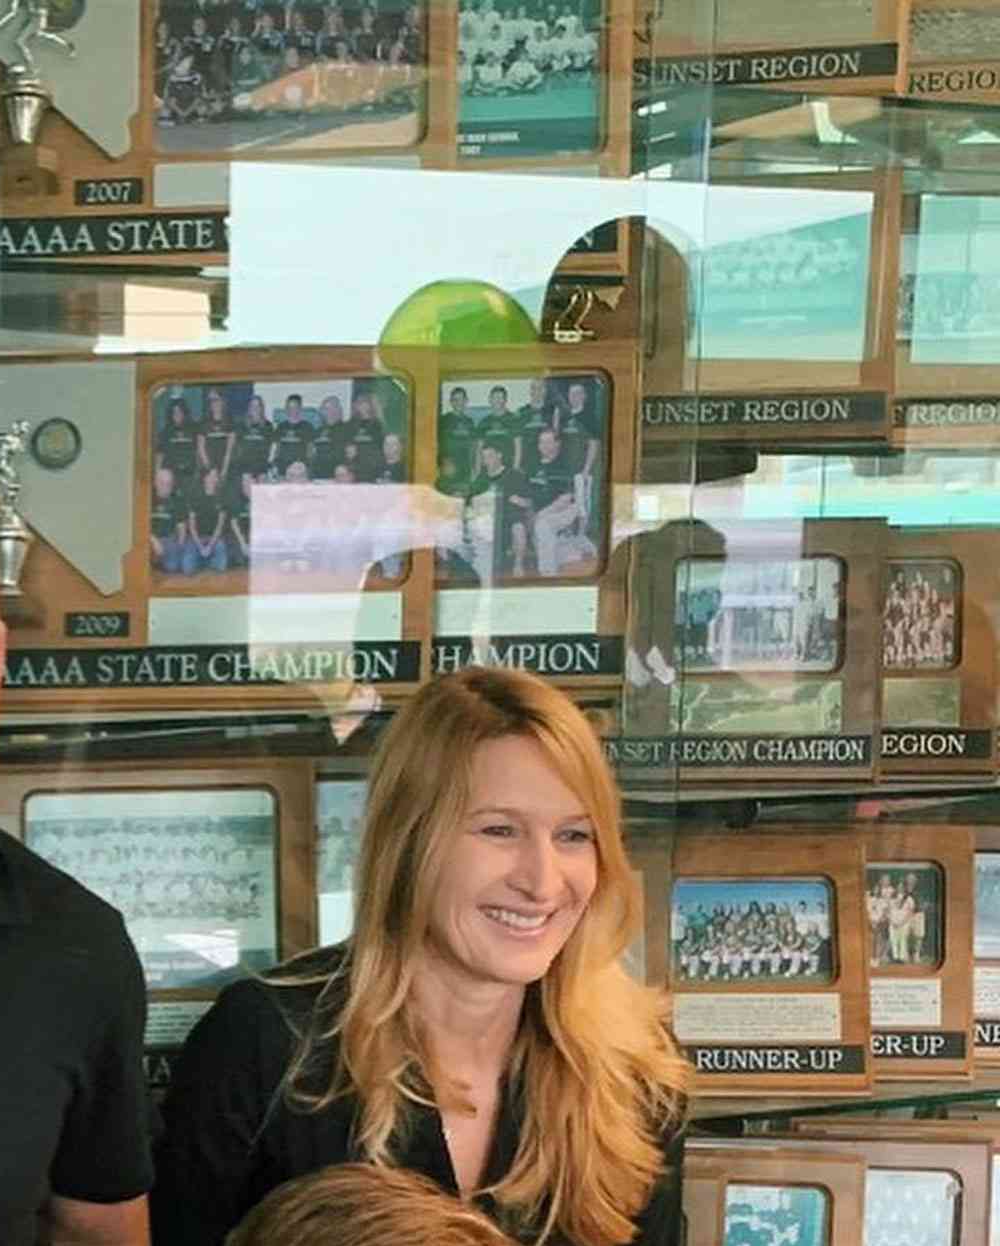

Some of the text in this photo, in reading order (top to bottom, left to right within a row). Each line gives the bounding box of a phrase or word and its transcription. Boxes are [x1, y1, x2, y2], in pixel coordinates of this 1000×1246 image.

[632, 52, 861, 86] SUNSET REGION
[86, 180, 132, 203] 2007
[106, 218, 215, 252] STATE
[743, 399, 850, 422] REGION
[74, 615, 121, 634] 2009
[96, 652, 199, 682] STATE
[208, 649, 397, 682] CHAMPION
[752, 737, 865, 762] CHAMPION
[881, 733, 966, 756] EGION
[872, 1034, 945, 1055] ER-UP
[697, 1049, 844, 1070] RUNNER-UP
